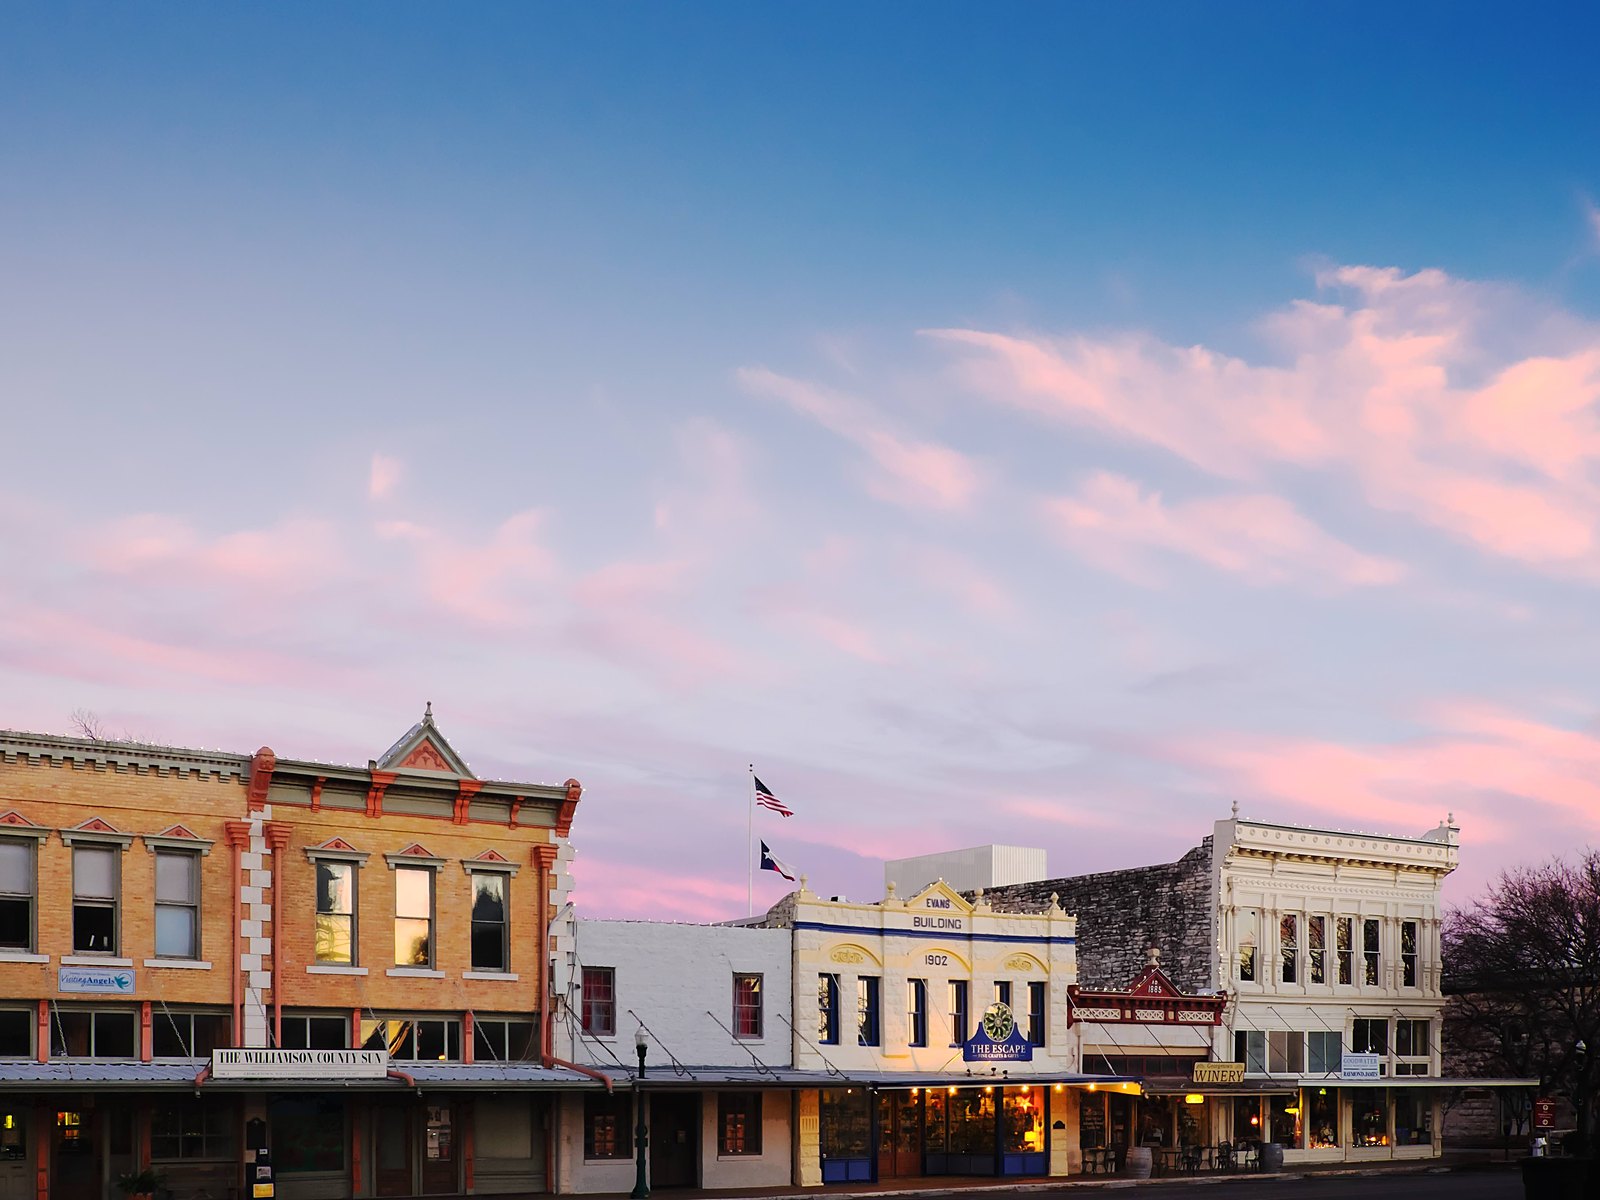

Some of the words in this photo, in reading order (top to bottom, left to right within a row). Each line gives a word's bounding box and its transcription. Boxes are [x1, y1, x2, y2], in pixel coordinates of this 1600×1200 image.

[926, 898, 950, 909] EVANS
[913, 916, 962, 929] BUILDING
[925, 955, 948, 966] 1902
[61, 974, 87, 987] Visiting
[87, 976, 115, 985] Angels
[971, 1044, 990, 1054] THE
[992, 1044, 1026, 1054] ESCAPE
[219, 1051, 241, 1064] THE
[244, 1051, 313, 1064] WILLIAMSON
[316, 1052, 357, 1064] COUNTY
[361, 1052, 382, 1064] SUN
[1195, 1070, 1243, 1081] WINERY
